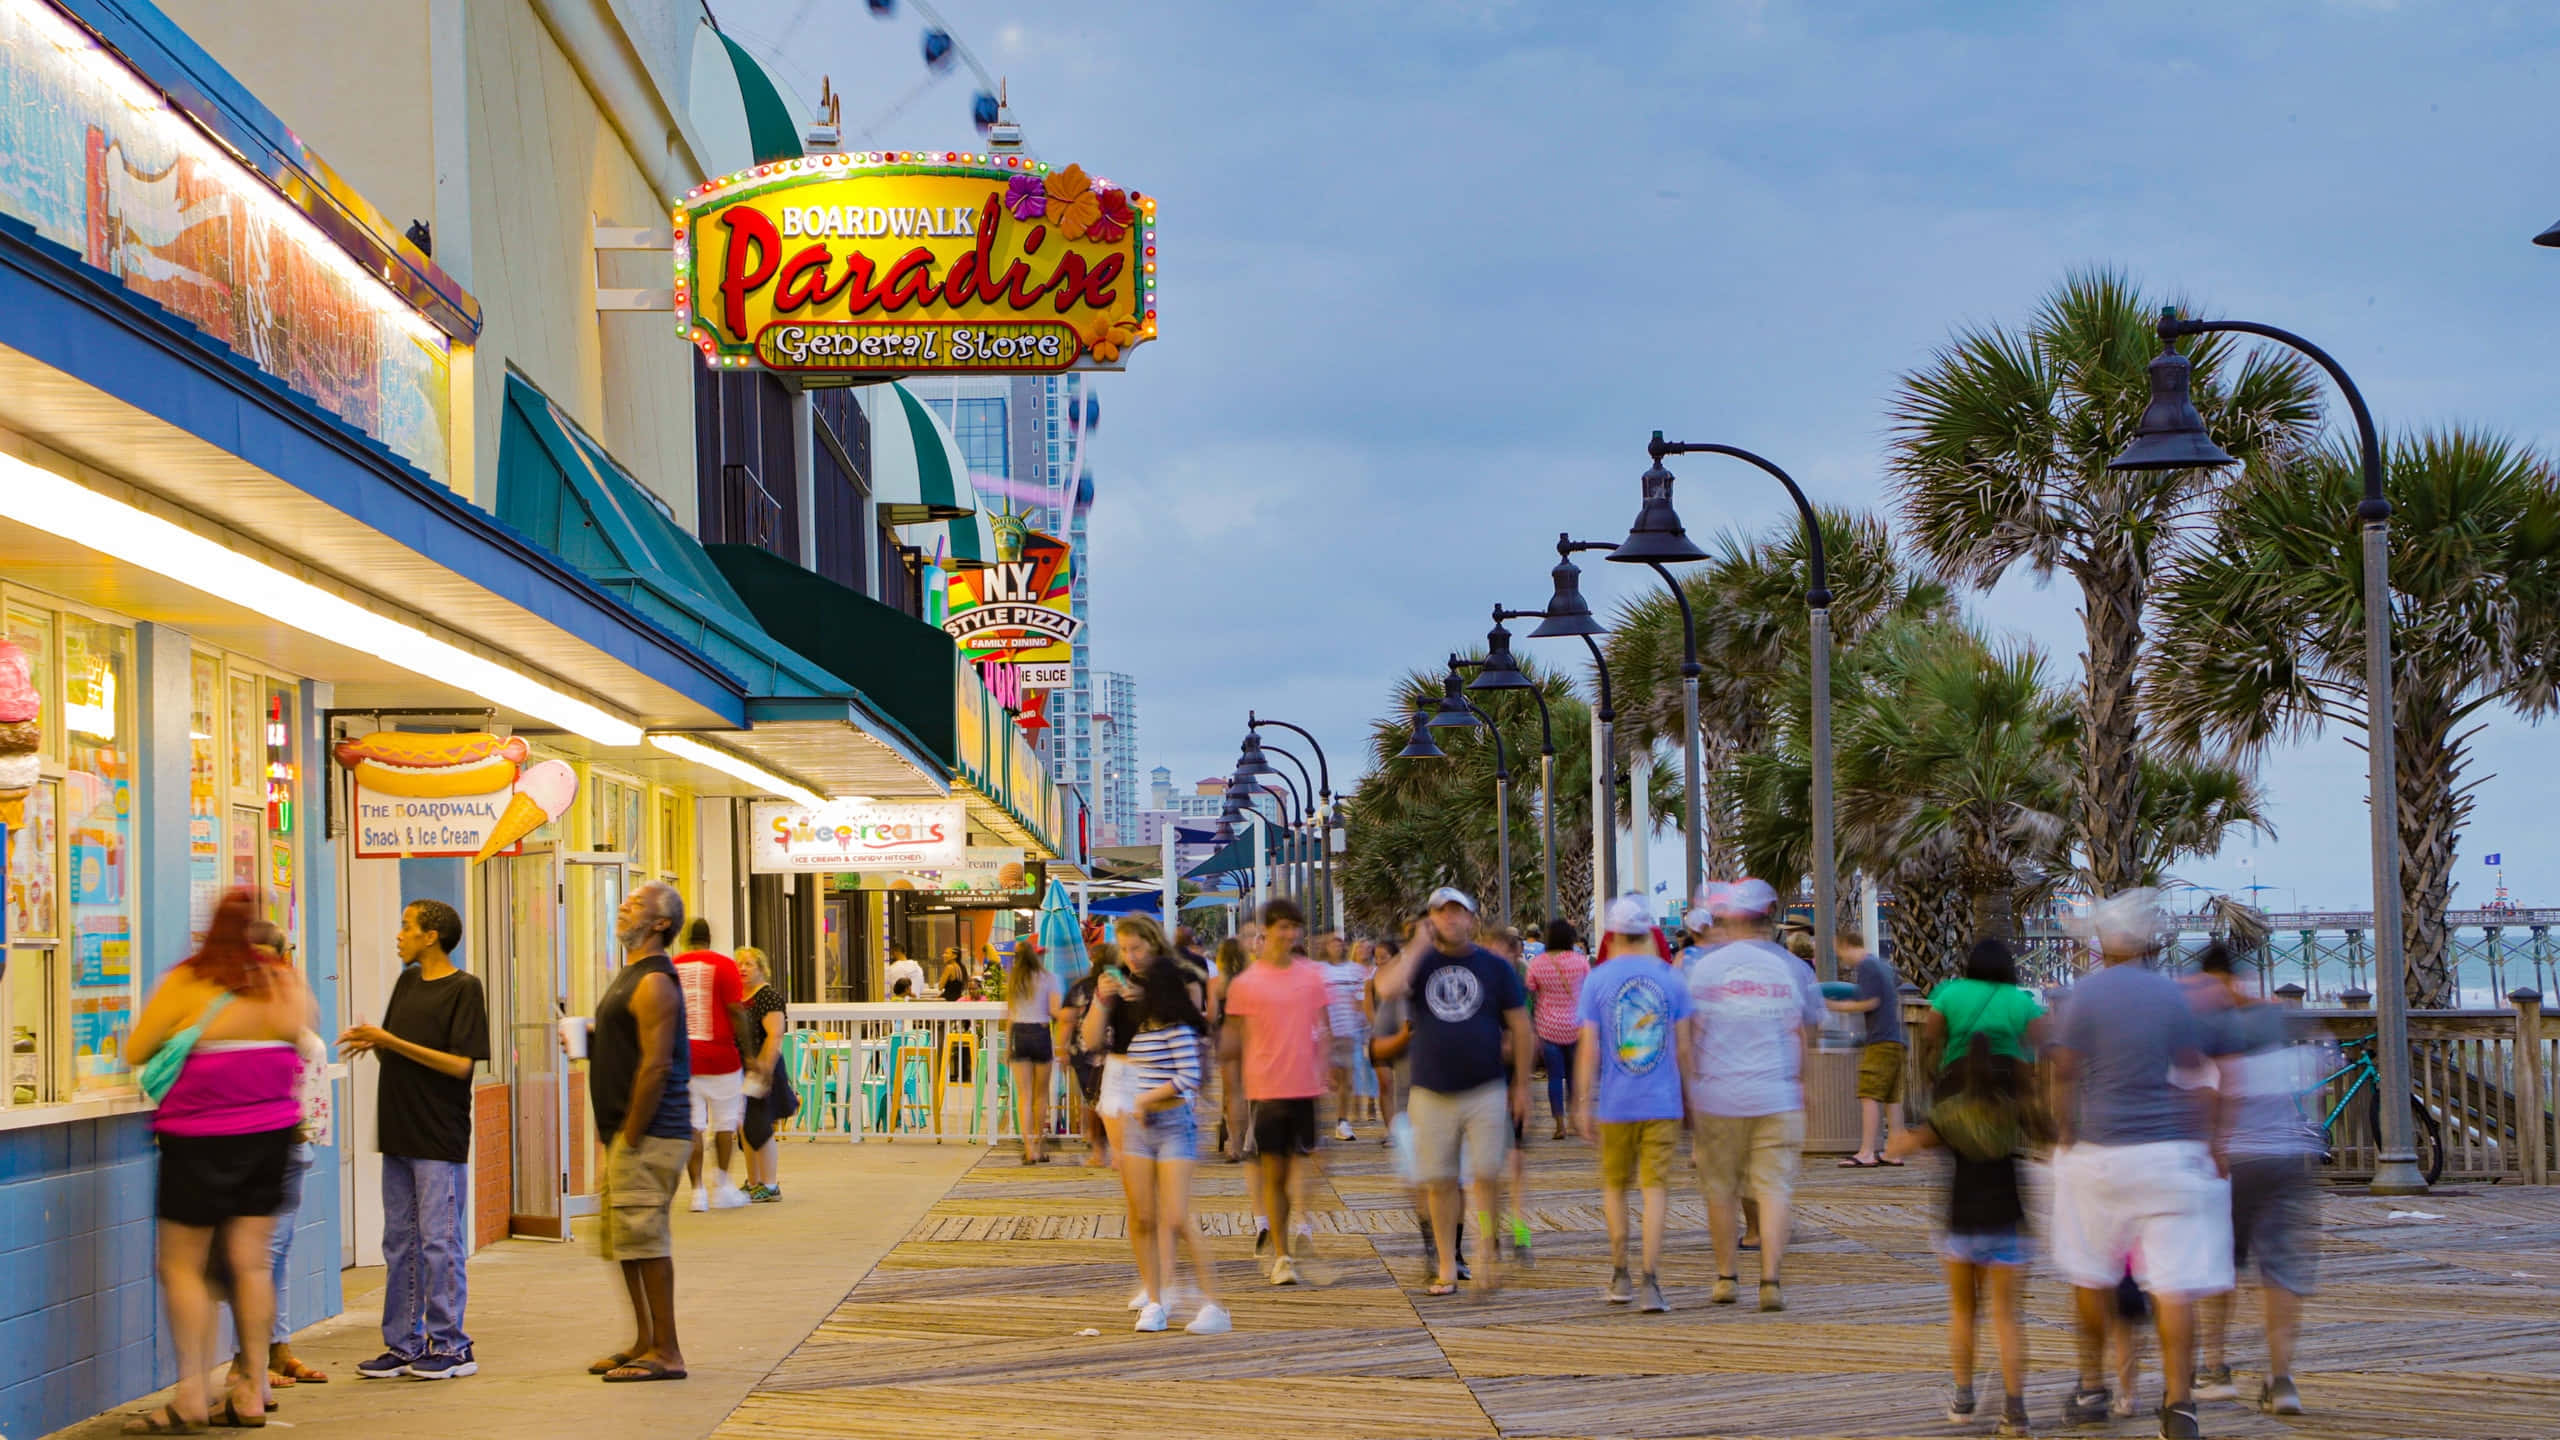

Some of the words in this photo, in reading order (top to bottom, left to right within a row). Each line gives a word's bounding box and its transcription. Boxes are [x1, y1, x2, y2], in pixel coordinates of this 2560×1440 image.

[783, 207, 975, 237] BOARDWALK
[721, 193, 1126, 341] Paradise
[776, 327, 938, 363] General
[951, 329, 1060, 359] Store
[945, 608, 1008, 637] STYLE
[1013, 607, 1072, 636] PIZZA
[971, 638, 1008, 649] FAMILY
[1011, 638, 1047, 648] DINING
[1036, 669, 1067, 682] SLICE
[360, 804, 390, 818] THE
[396, 802, 498, 820] BOARDWALK
[364, 827, 400, 847] Snack
[407, 827, 415, 845] &
[418, 827, 437, 845] Ice
[441, 826, 480, 845] Cream
[795, 856, 809, 864] ICE
[811, 855, 842, 864] CREAM
[844, 855, 850, 863] &
[852, 855, 882, 863] CANDY
[968, 859, 998, 870] ream
